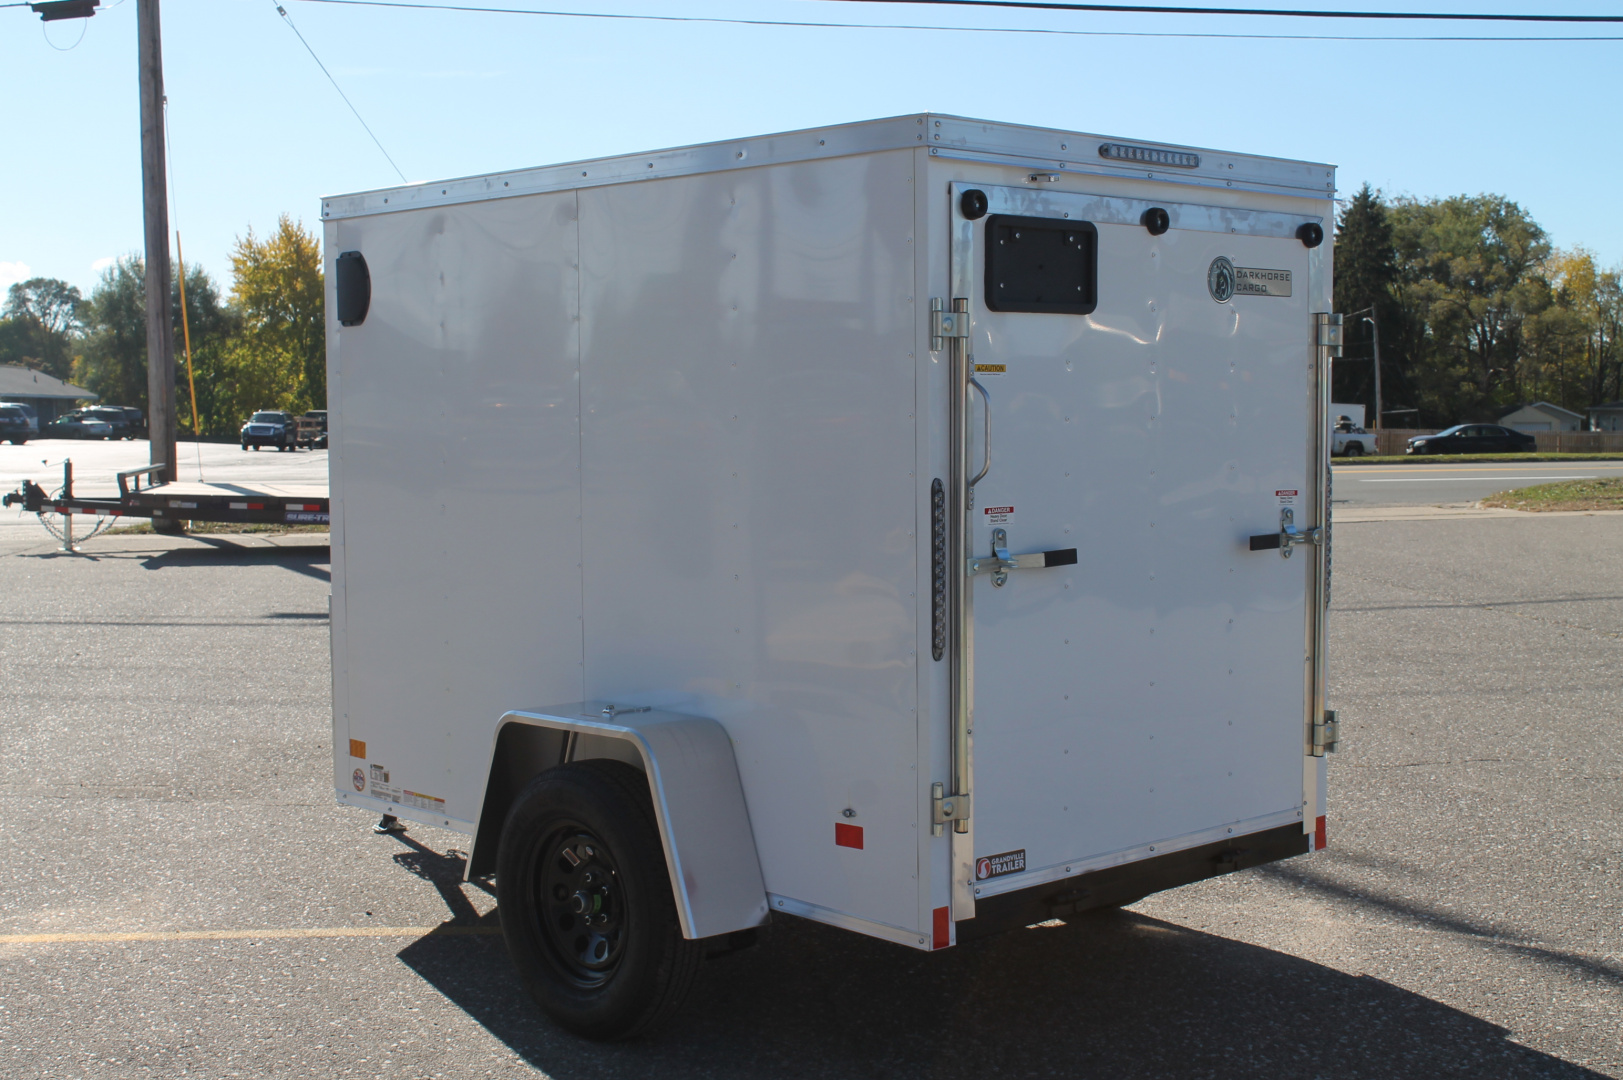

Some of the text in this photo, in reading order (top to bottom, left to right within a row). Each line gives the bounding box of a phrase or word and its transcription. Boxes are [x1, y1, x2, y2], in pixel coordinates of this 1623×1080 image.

[1237, 271, 1290, 281] DARKHORSE
[1237, 283, 1267, 293] CARGO
[981, 364, 1004, 372] CAUTION
[991, 852, 1024, 865] GRANDVILLE
[991, 859, 1024, 874] TRAILER
